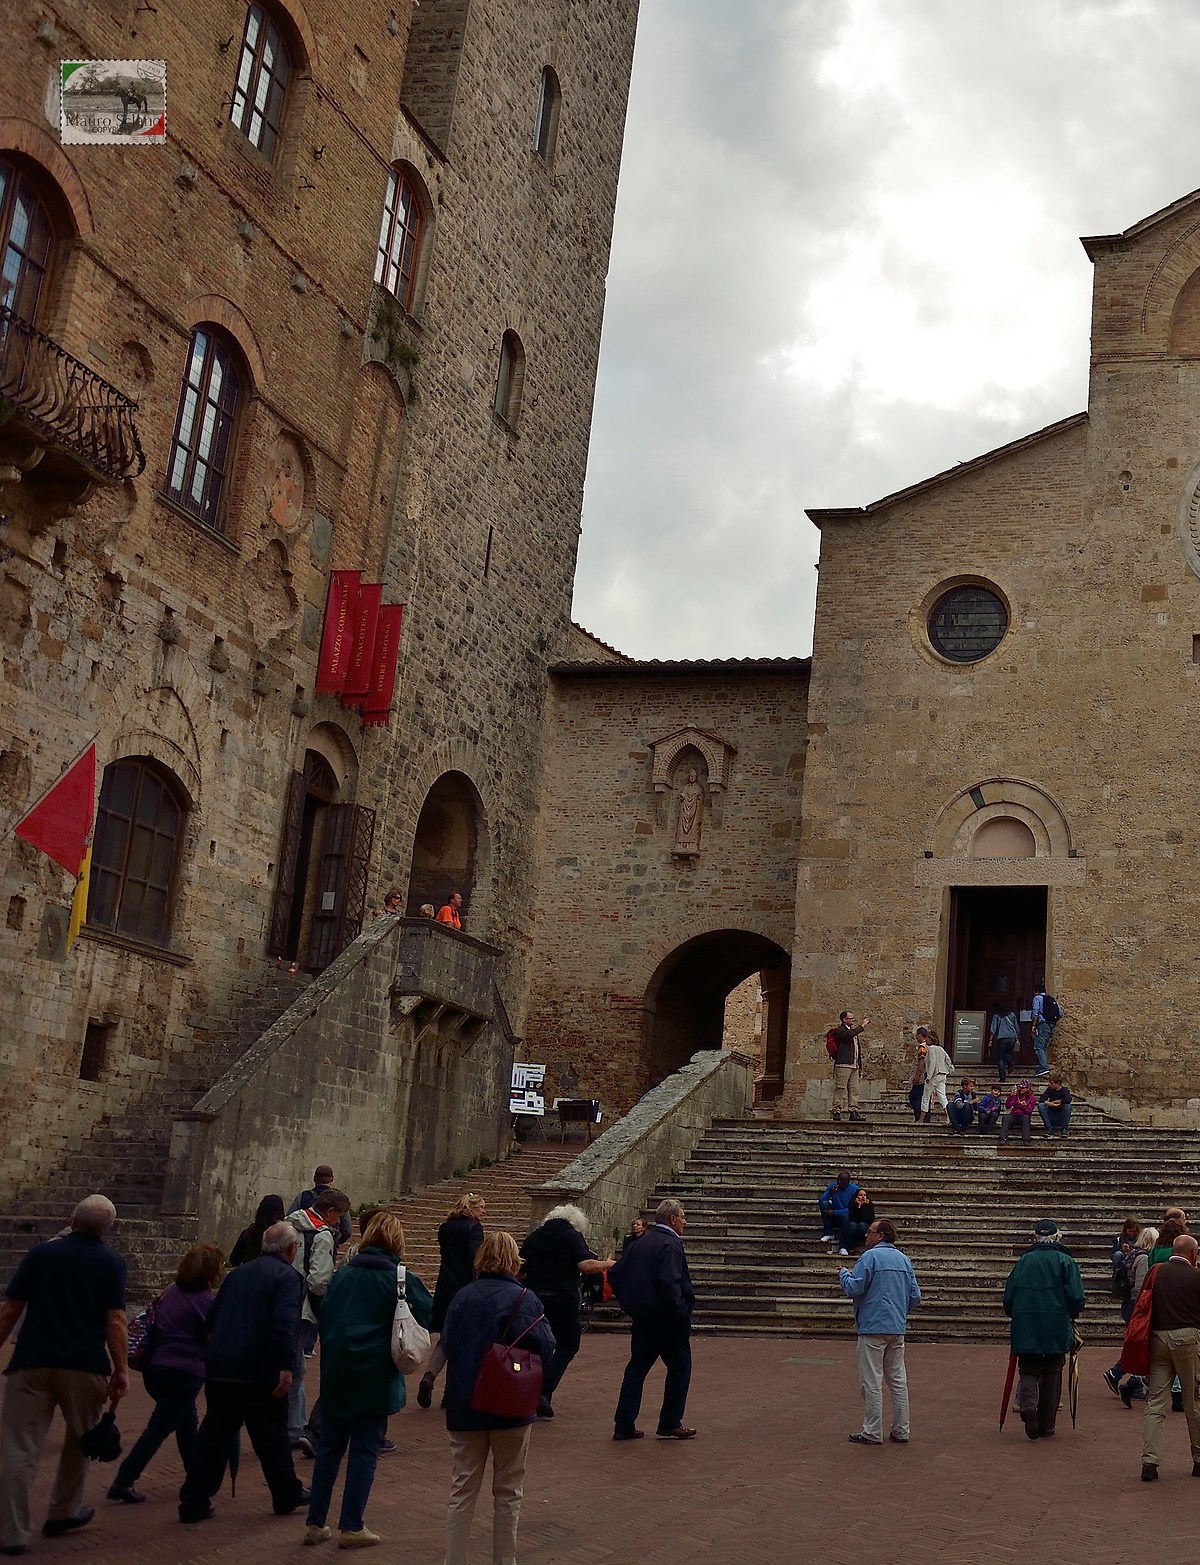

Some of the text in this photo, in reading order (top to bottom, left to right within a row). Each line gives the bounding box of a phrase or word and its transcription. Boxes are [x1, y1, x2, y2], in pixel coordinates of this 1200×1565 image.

[331, 582, 349, 674] PALAZZO COMUNALE
[355, 609, 369, 667] PINACOTECA
[377, 623, 391, 692] TORRE GROSSA
